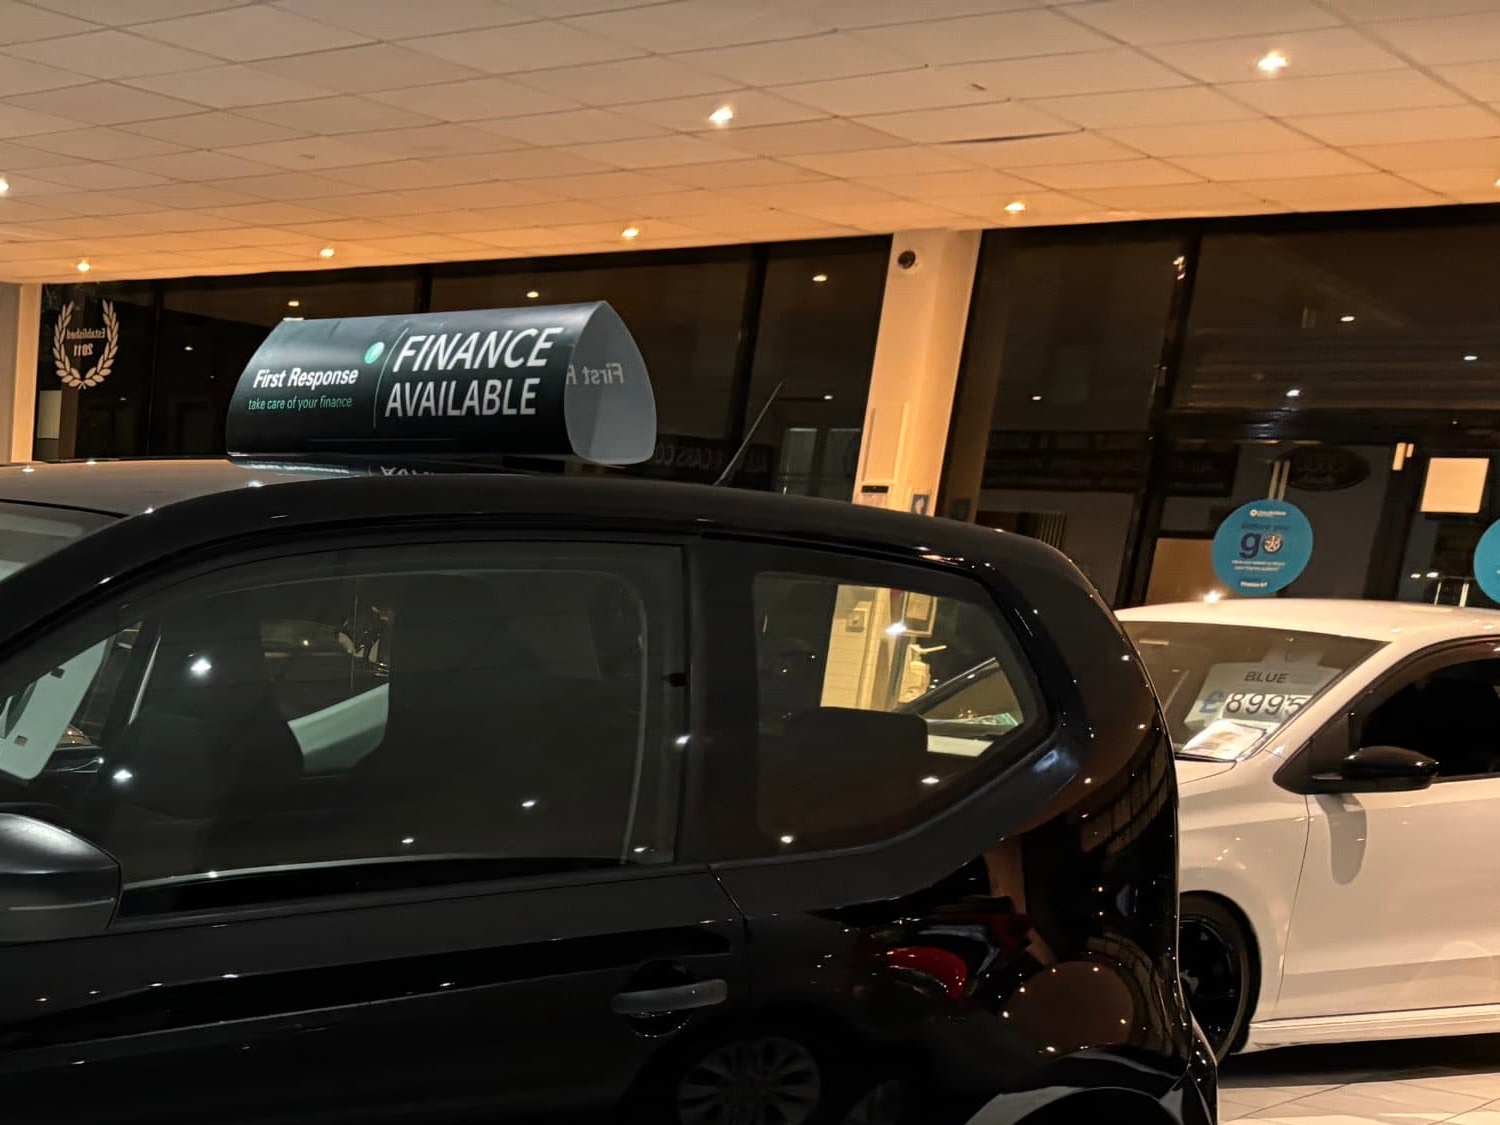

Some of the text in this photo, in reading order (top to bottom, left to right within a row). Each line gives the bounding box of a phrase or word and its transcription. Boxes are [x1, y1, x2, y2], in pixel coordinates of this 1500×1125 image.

[392, 326, 564, 372] FINANCE
[252, 367, 359, 391] First Response
[248, 396, 353, 413] take care of your finance
[384, 378, 540, 417] AVAILABLE
[1244, 671, 1290, 684] BLUE
